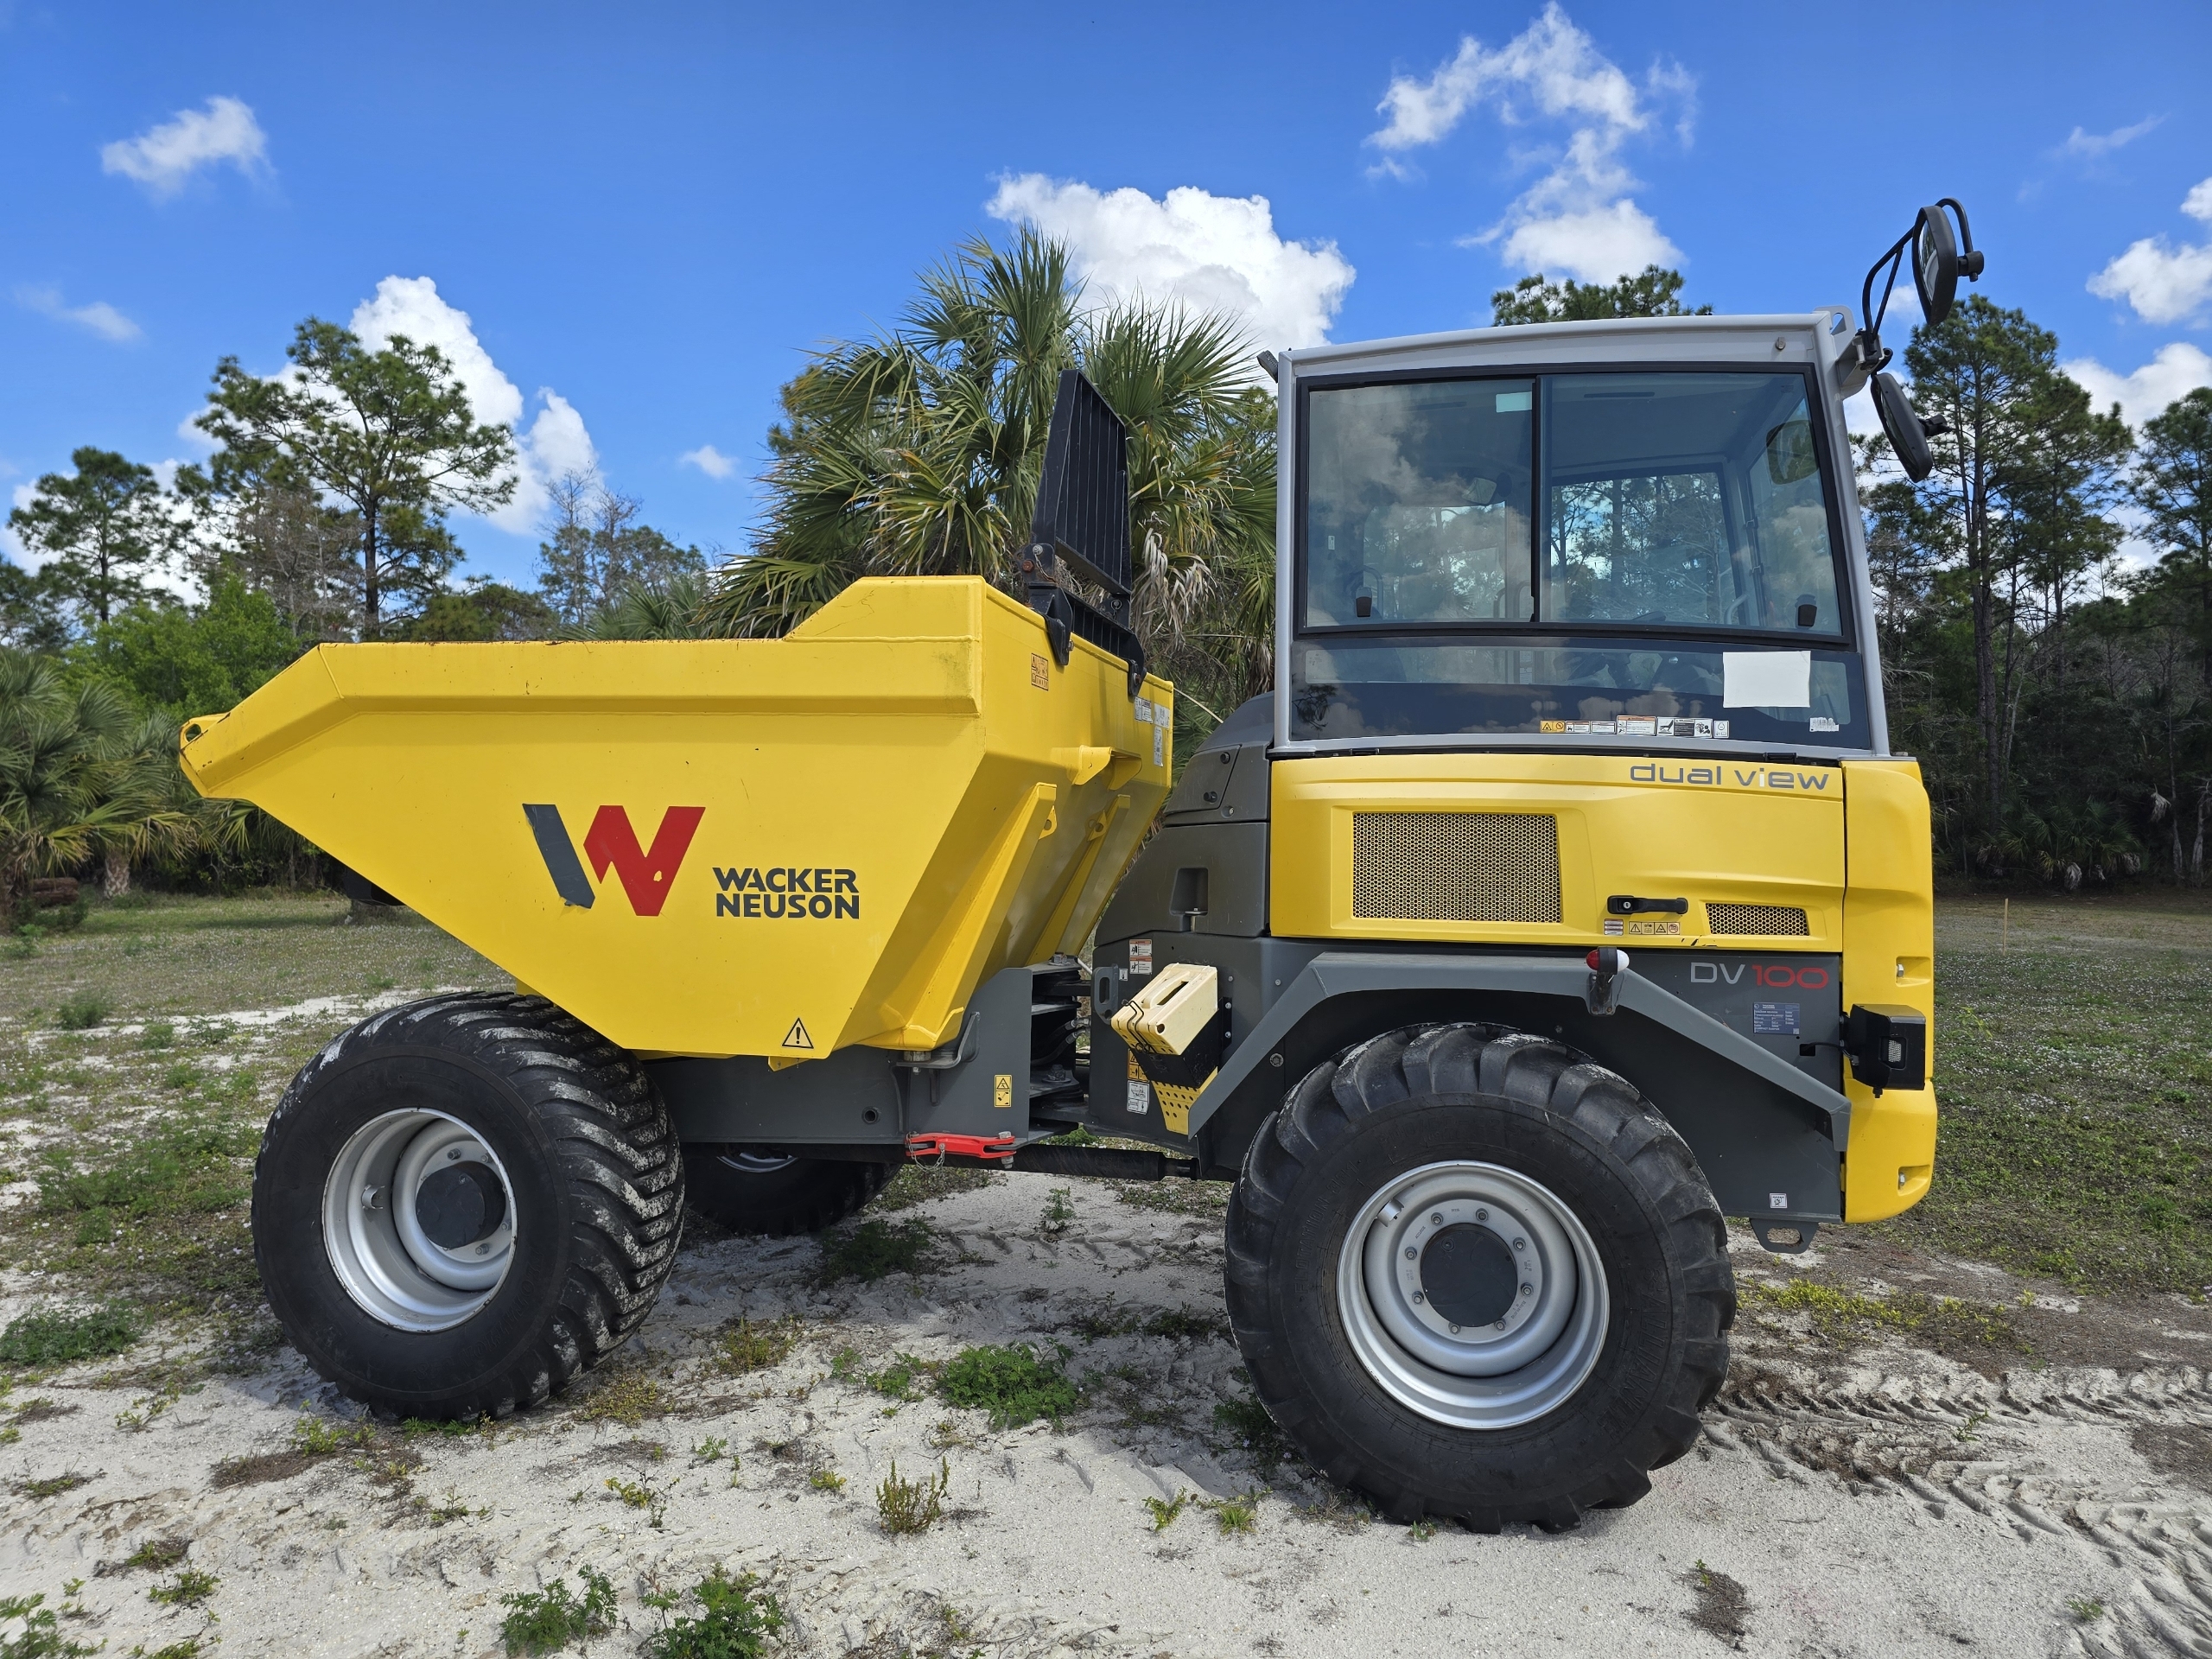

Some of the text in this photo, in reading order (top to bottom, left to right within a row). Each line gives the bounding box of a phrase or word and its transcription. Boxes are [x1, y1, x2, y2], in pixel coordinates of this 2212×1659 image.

[1630, 763, 1829, 790] dual view
[712, 867, 860, 893] WACKER
[715, 893, 860, 919] NEUSON
